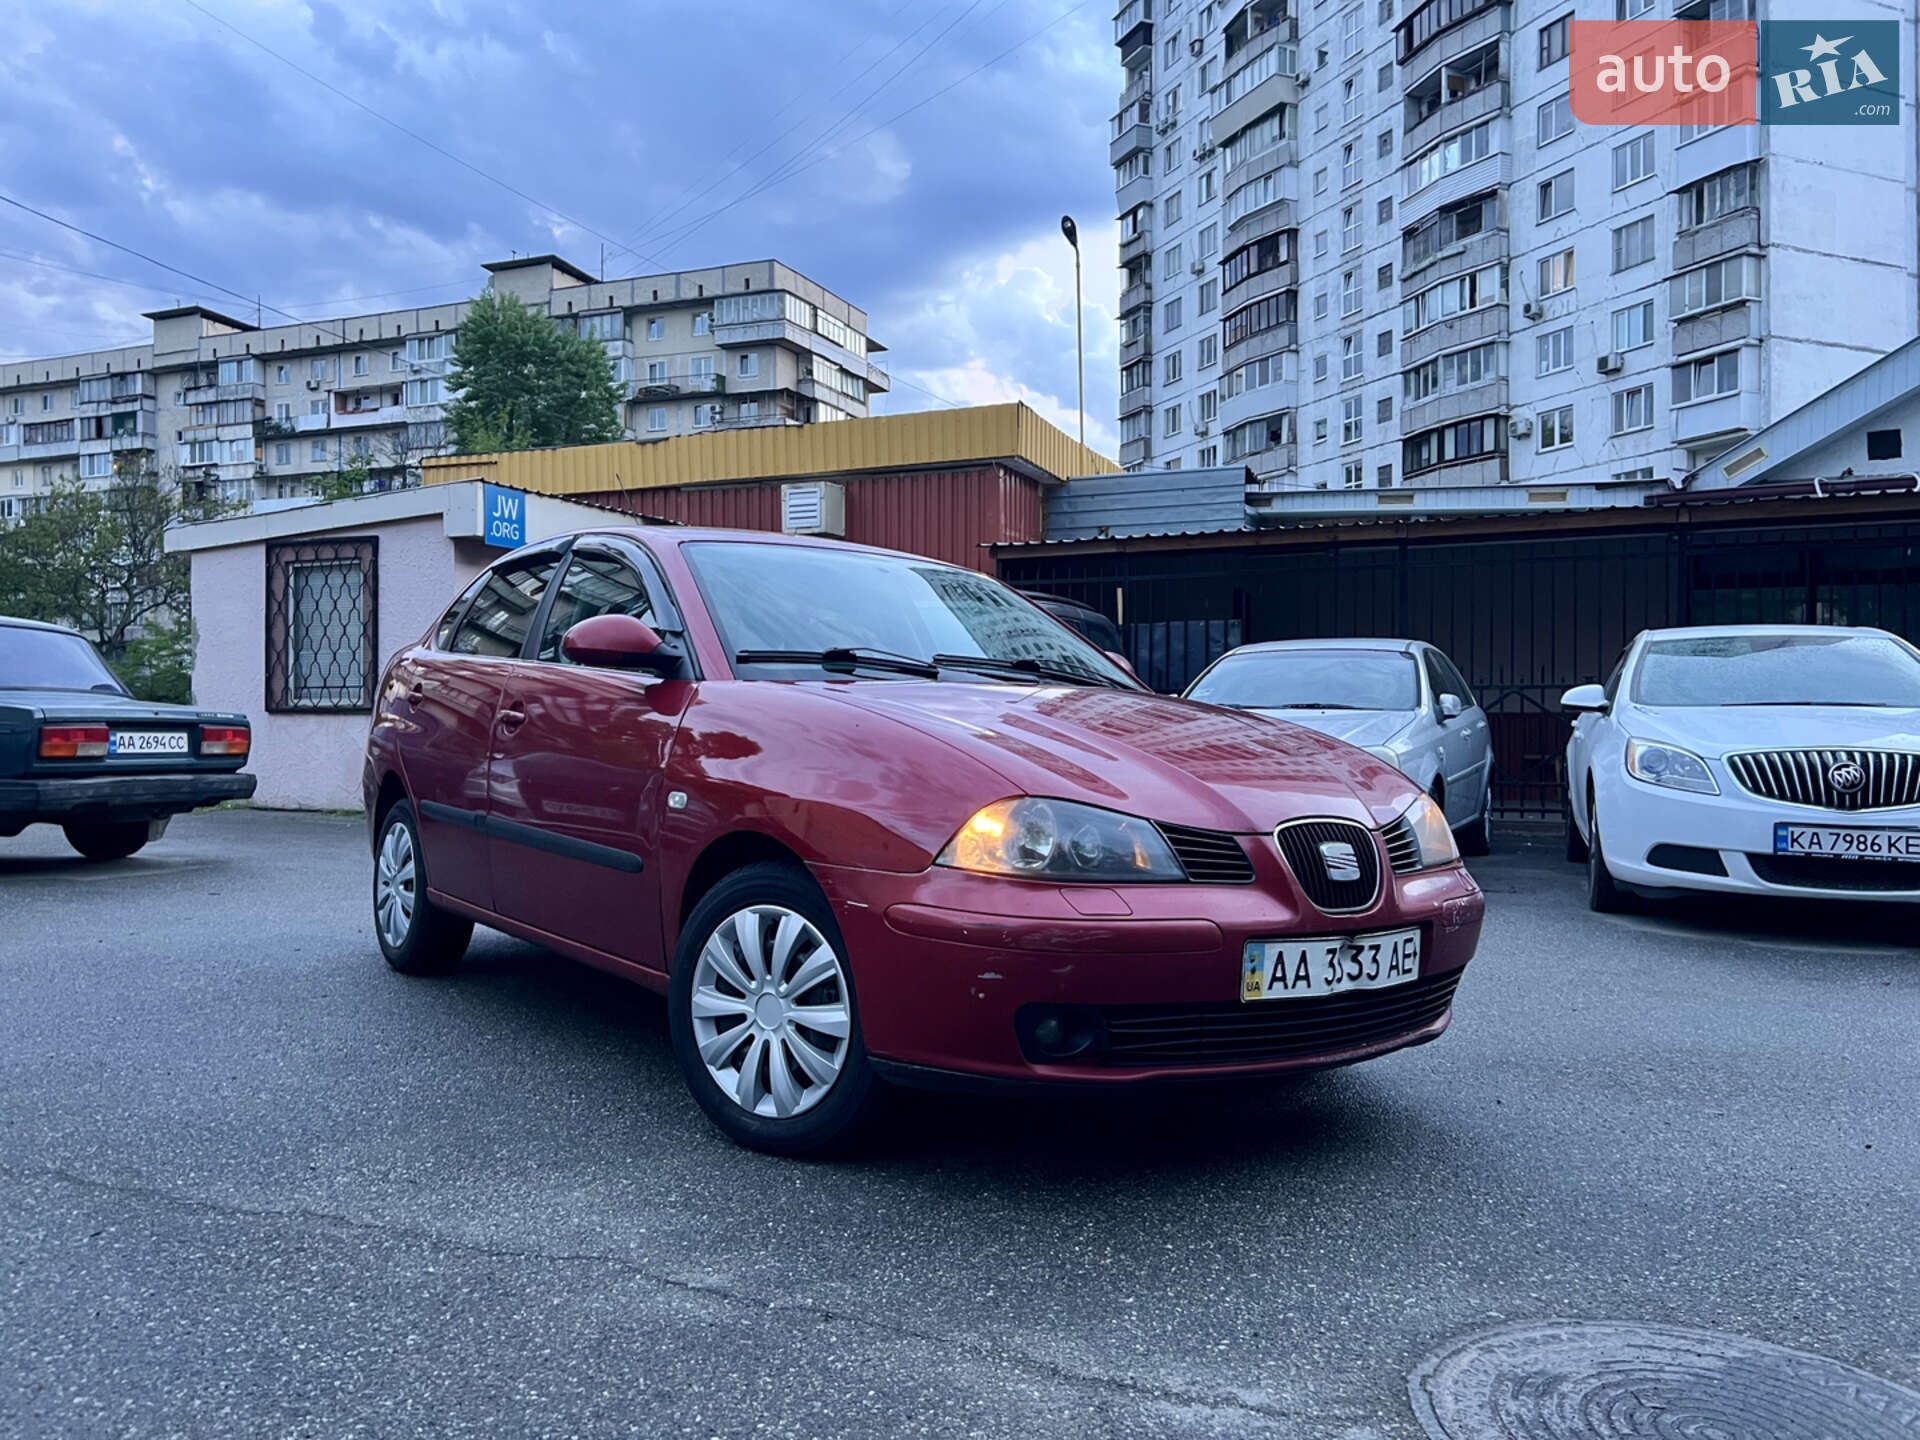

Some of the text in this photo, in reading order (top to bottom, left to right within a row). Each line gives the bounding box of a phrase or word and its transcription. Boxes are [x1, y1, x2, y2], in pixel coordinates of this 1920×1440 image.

[492, 495, 519, 520] JW
[490, 520, 520, 540] .ORG
[118, 735, 185, 750] AA 2694 CC
[1790, 830, 1823, 850] KA
[1828, 832, 1882, 853] 7986
[1267, 950, 1312, 991] AA
[1387, 937, 1414, 979] AE
[1246, 981, 1261, 992] UA
